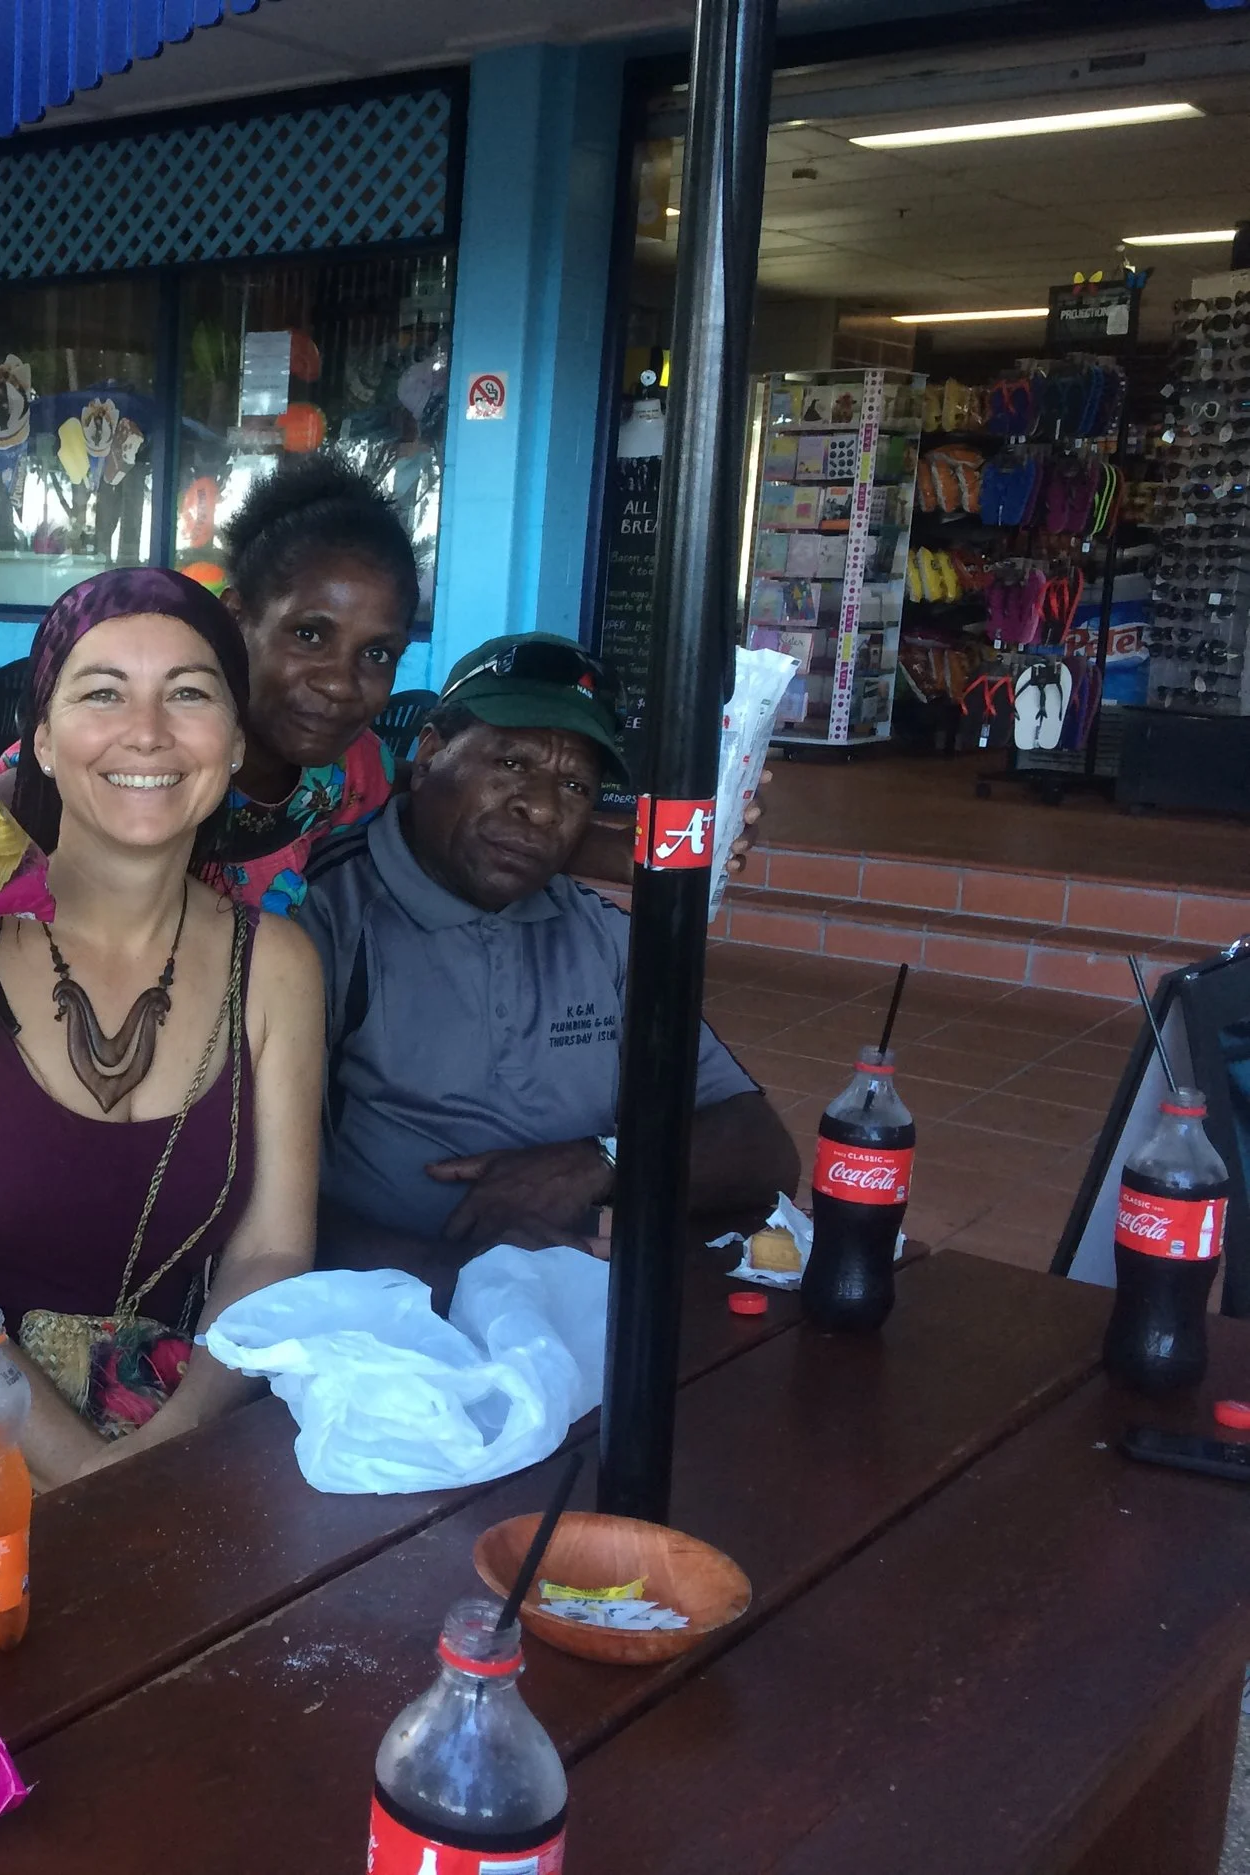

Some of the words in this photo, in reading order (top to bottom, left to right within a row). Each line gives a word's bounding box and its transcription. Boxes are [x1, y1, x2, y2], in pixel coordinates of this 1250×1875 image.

[623, 500, 652, 515] ALL
[602, 794, 637, 805] ORDERS
[566, 1005, 575, 1018] K
[576, 1004, 584, 1016] &
[585, 1003, 595, 1015] M
[550, 1019, 592, 1033] PLUMBING
[594, 1018, 602, 1027] &
[549, 1032, 593, 1047] THURSDAY
[847, 1152, 884, 1163] CLASSIC
[828, 1161, 899, 1191] Coca-Cola
[1123, 1193, 1151, 1209] CLASSIC
